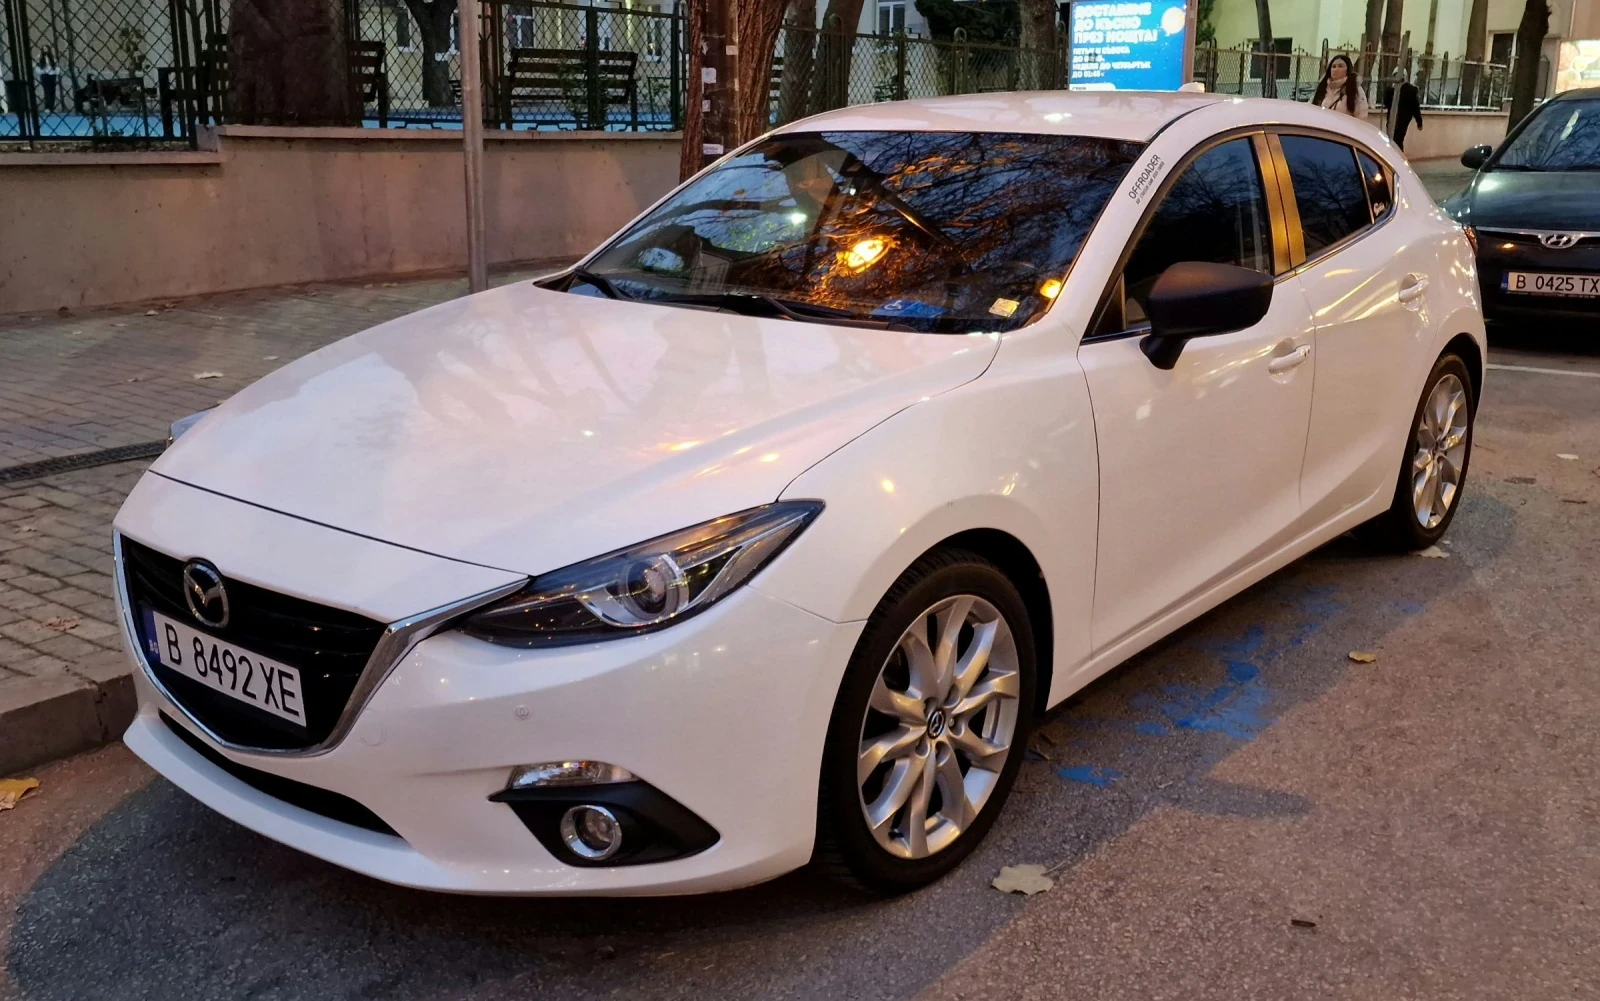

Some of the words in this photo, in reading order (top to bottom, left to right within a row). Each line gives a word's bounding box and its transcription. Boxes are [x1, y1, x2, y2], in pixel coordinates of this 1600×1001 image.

[1074, 3, 1151, 19] ДОСТАВЯМЕ
[1074, 18, 1094, 32] ДО
[1095, 16, 1141, 30] КЪСНО
[1074, 31, 1104, 43] ПРЕЗ
[1105, 30, 1157, 44] НОЩТА!
[1128, 154, 1161, 199] OFFROADER
[1516, 275, 1526, 289] B
[1535, 275, 1574, 291] 0425
[1579, 277, 1600, 293] TX
[164, 622, 181, 665] B
[193, 636, 257, 700] 8492
[259, 661, 300, 717] XE
